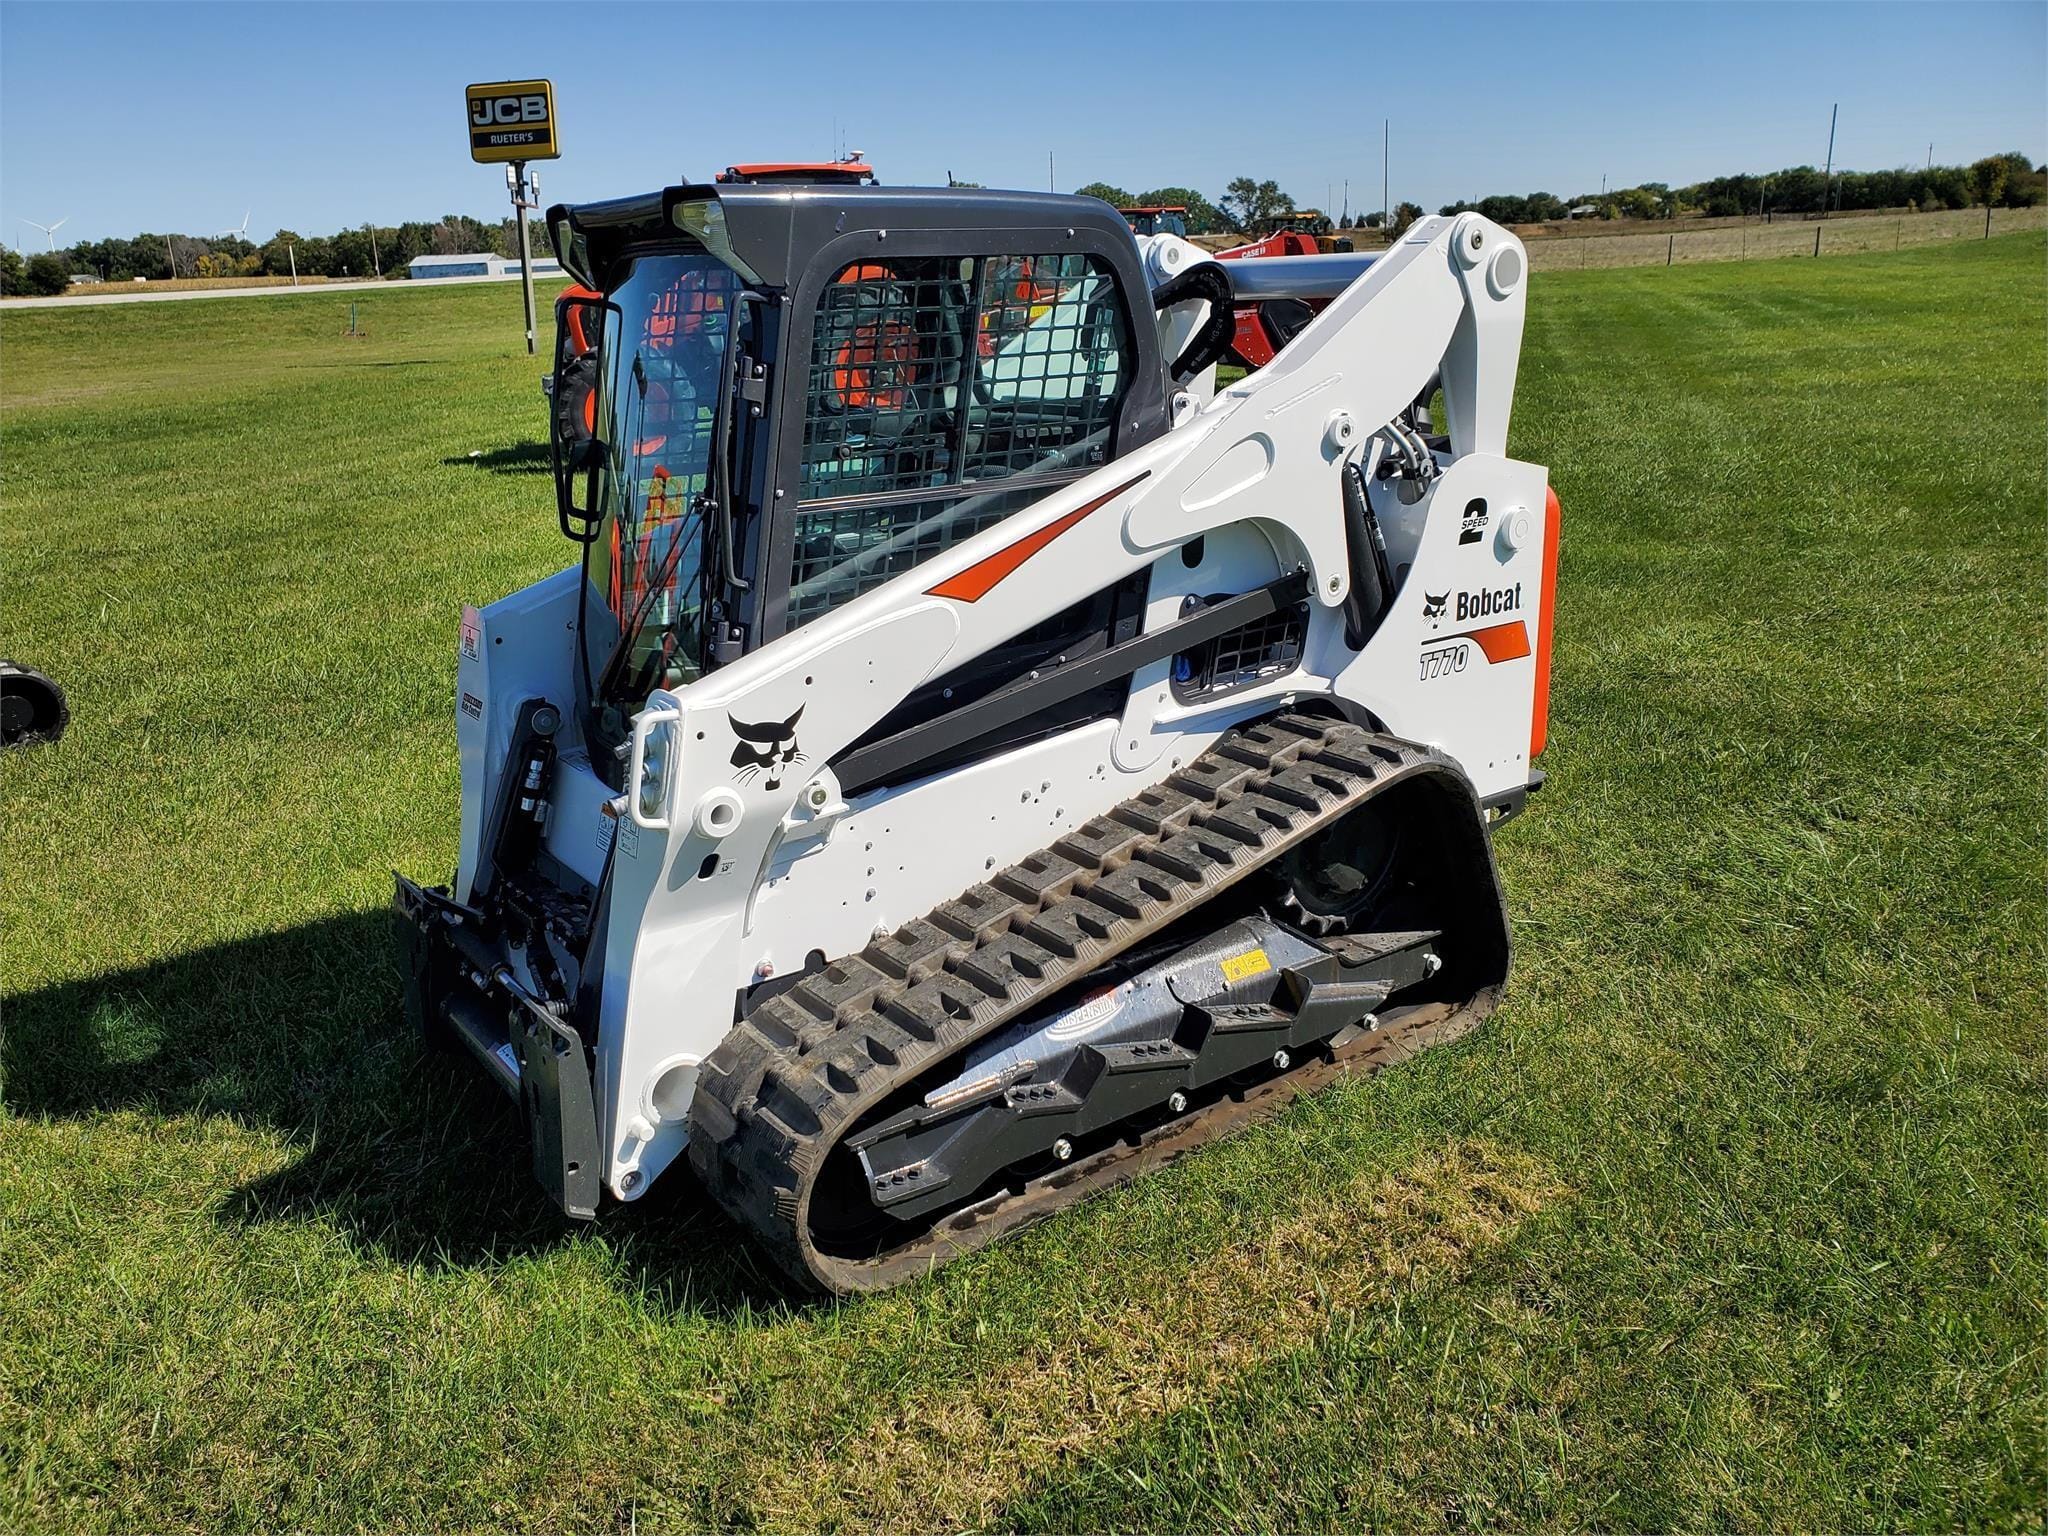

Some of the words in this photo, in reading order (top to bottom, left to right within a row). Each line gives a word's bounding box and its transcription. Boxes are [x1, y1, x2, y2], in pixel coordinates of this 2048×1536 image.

[473, 96, 548, 125] JCB
[490, 132, 534, 145] RUETER'S
[1241, 248, 1260, 259] CASE
[1459, 497, 1488, 545] 2
[1461, 516, 1489, 530] SPEED
[1456, 582, 1521, 622] Bobcat
[1420, 644, 1469, 681] T770
